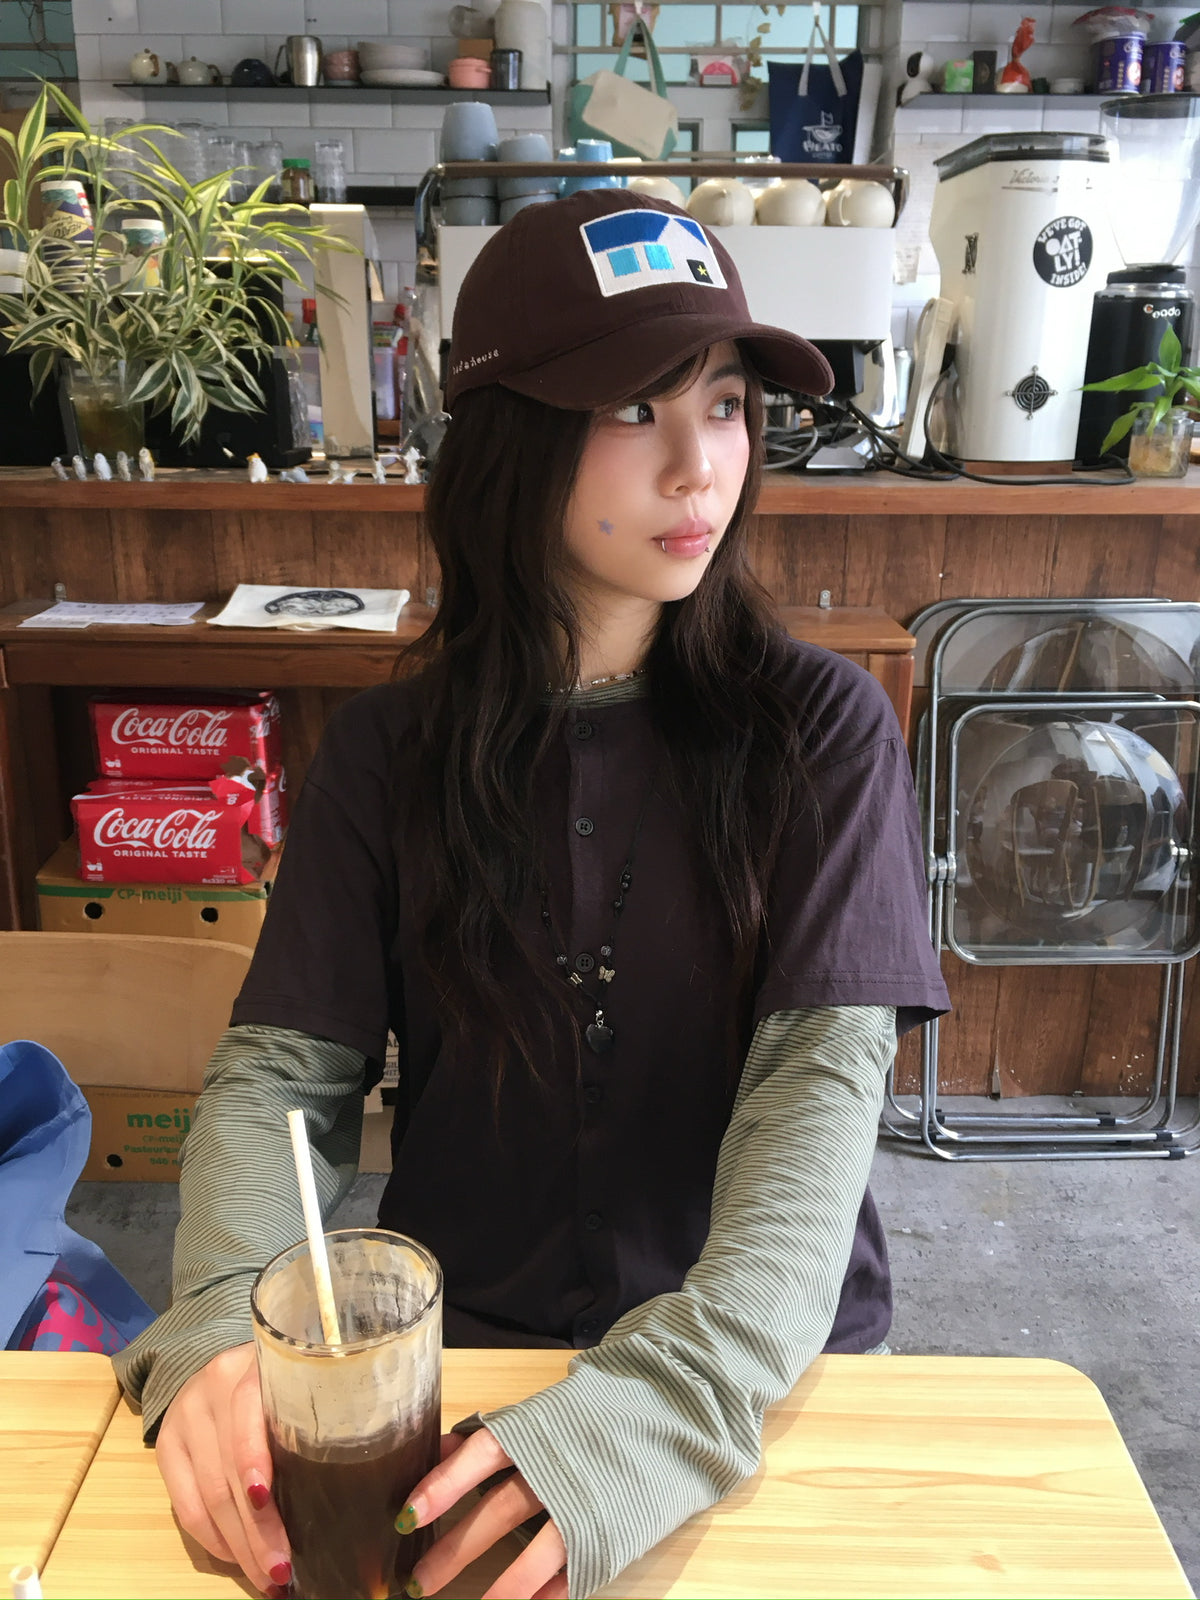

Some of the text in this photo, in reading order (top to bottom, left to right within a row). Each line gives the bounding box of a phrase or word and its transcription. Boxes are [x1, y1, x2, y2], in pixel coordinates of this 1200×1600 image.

[1068, 218, 1087, 231] GOT
[111, 707, 233, 747] Coca-Cola
[131, 747, 220, 756] ORIGINAL TASTE
[93, 807, 224, 850] Coca-Cola
[113, 850, 208, 859] ORIGINAL TASTE
[117, 888, 182, 903] CP-meiji
[127, 1108, 191, 1133] meij
